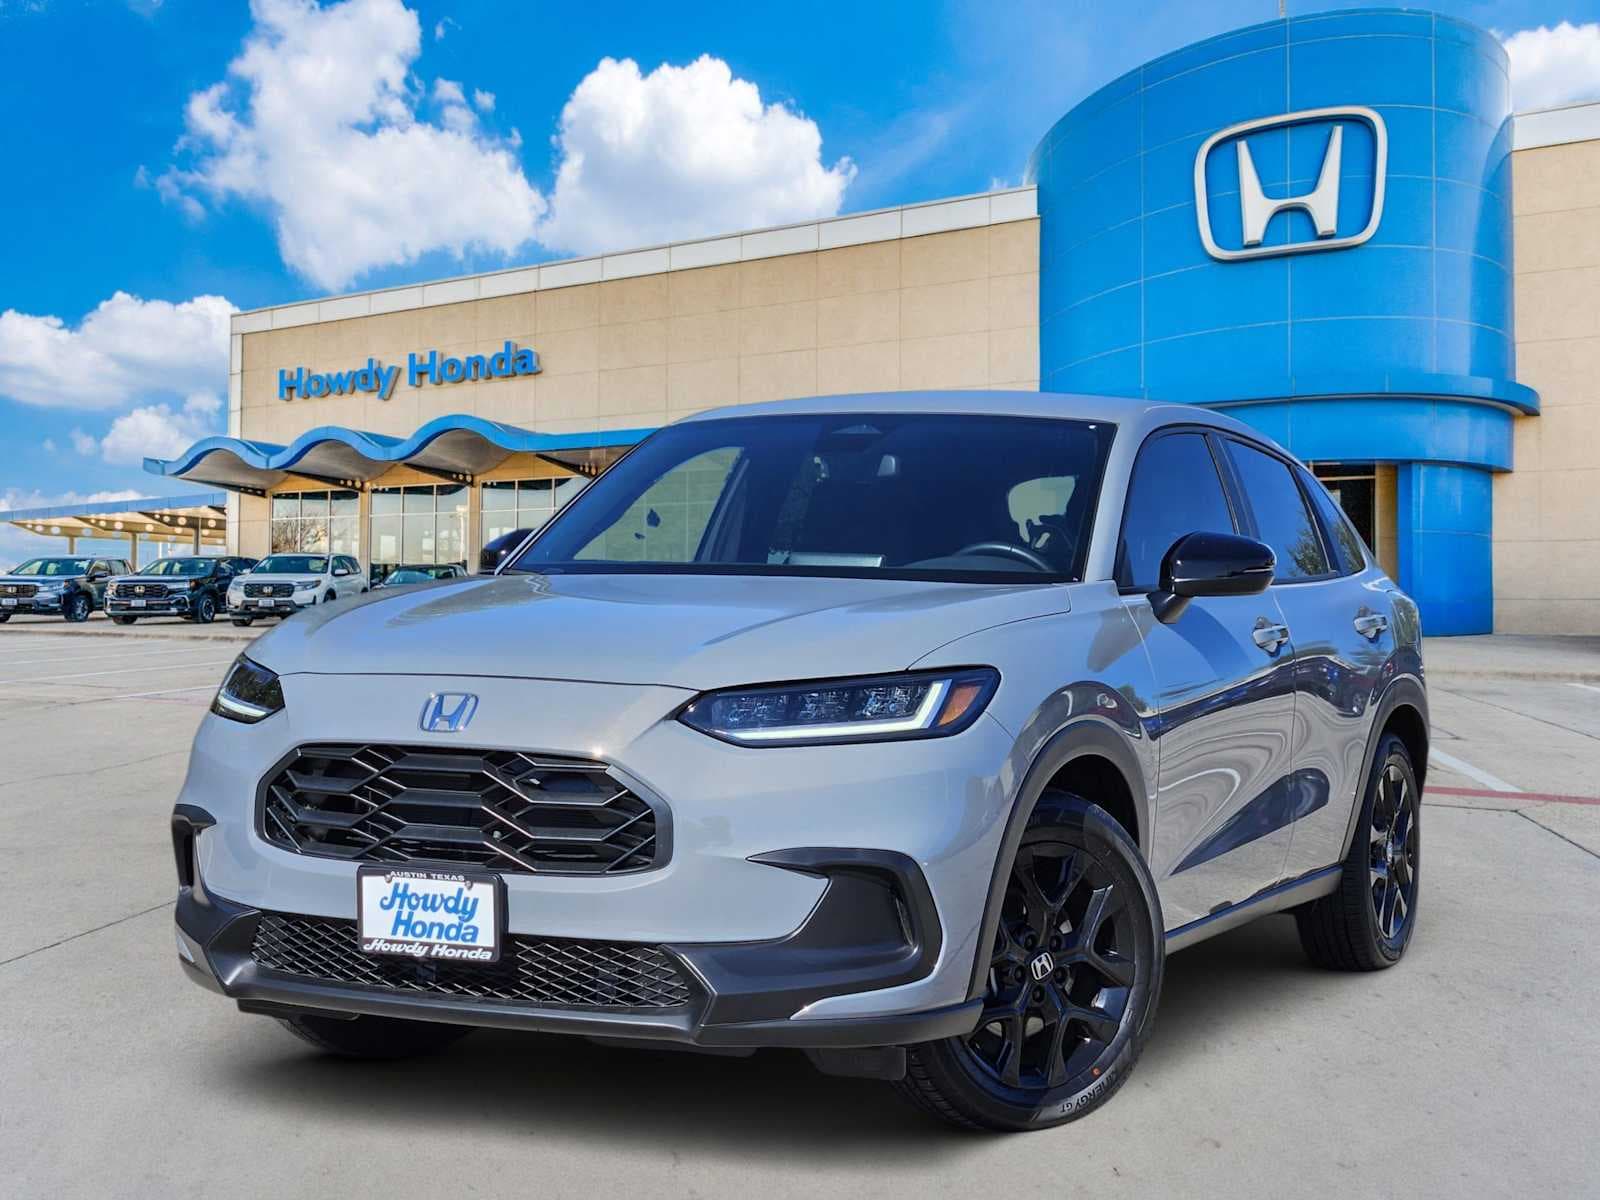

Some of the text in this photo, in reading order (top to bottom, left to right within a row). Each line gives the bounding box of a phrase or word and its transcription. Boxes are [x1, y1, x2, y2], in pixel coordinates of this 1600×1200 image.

[277, 340, 542, 401] Howdy Honda
[389, 870, 465, 882] AUSTIN TEXAS
[379, 882, 479, 923] Howdy
[391, 910, 479, 944] Honda
[363, 938, 492, 961] Howdy Honda
